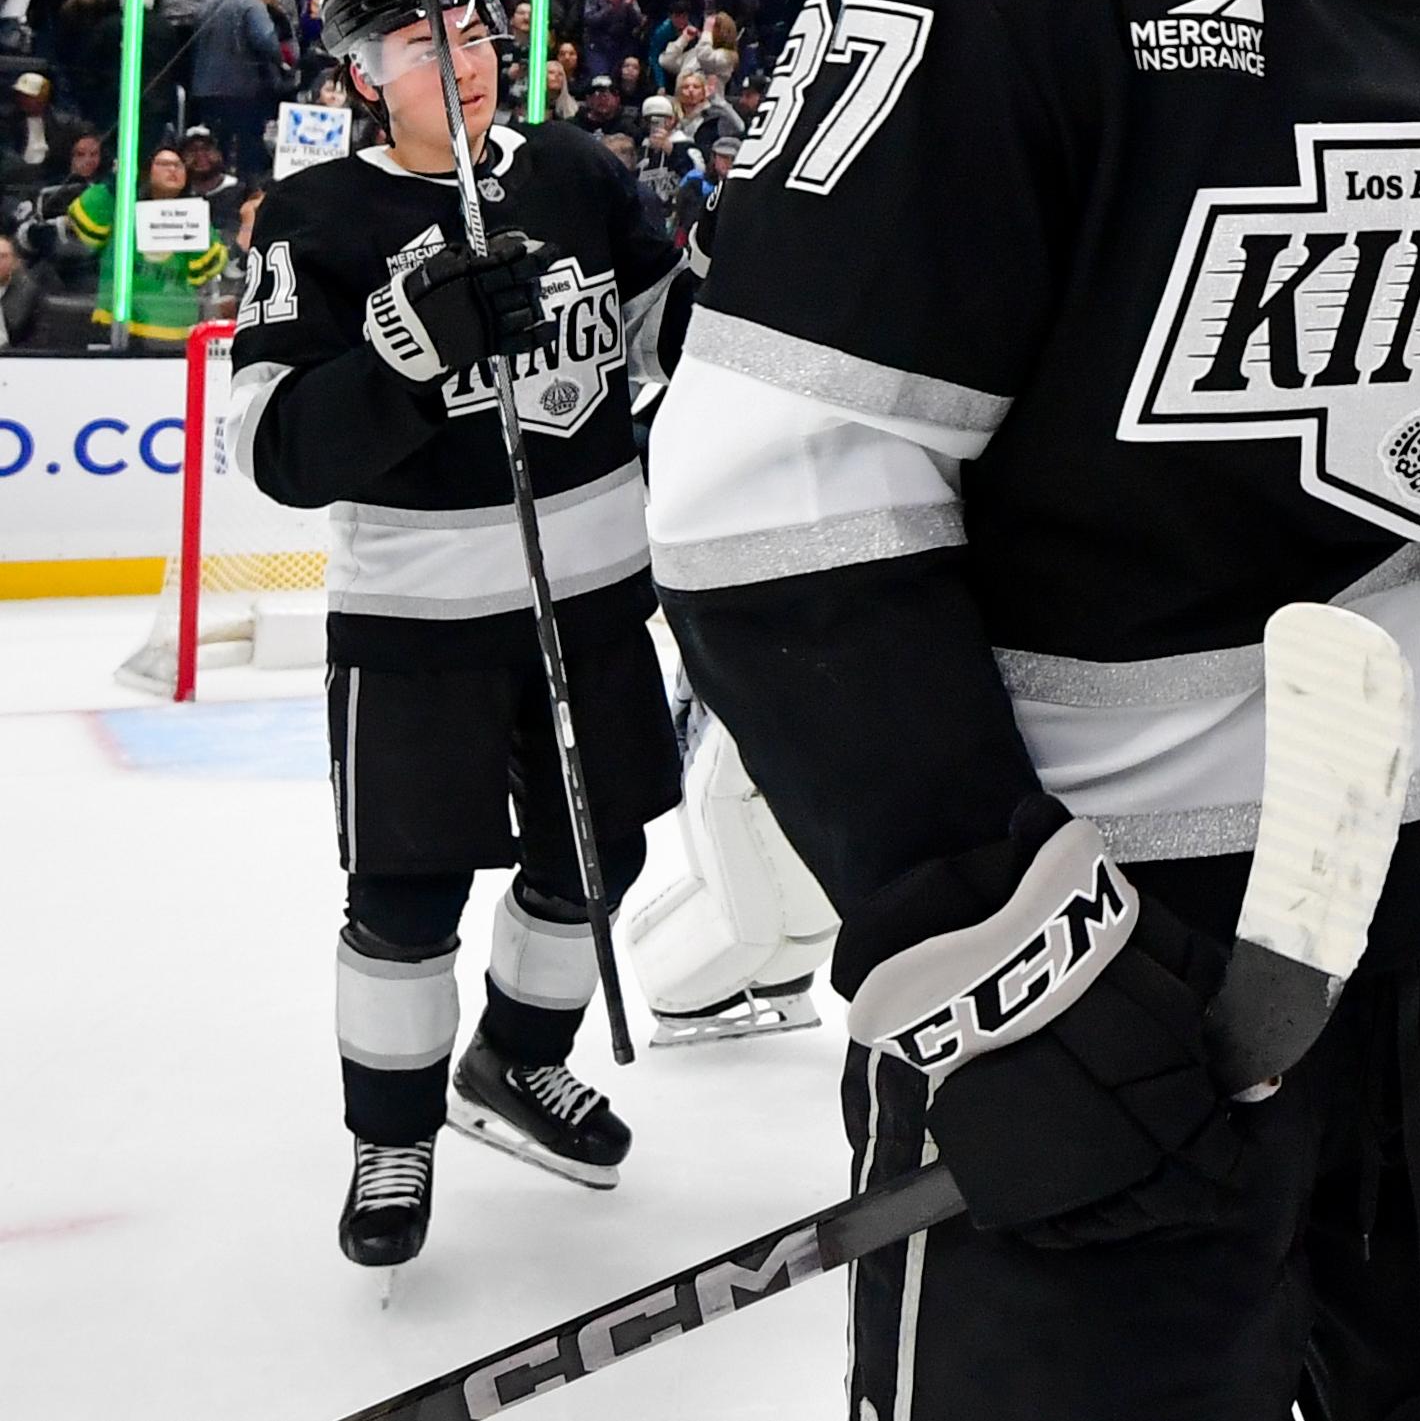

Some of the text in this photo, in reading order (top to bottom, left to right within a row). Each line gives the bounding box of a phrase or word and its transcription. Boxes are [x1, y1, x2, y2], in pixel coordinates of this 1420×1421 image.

[1131, 18, 1264, 51] MERCURY
[1134, 46, 1265, 77] INSURANCE
[1345, 169, 1404, 201] Los
[237, 240, 298, 335] 21
[451, 287, 618, 398] KNGS
[892, 860, 1127, 1068] CCM
[461, 1222, 828, 1421] CCM
